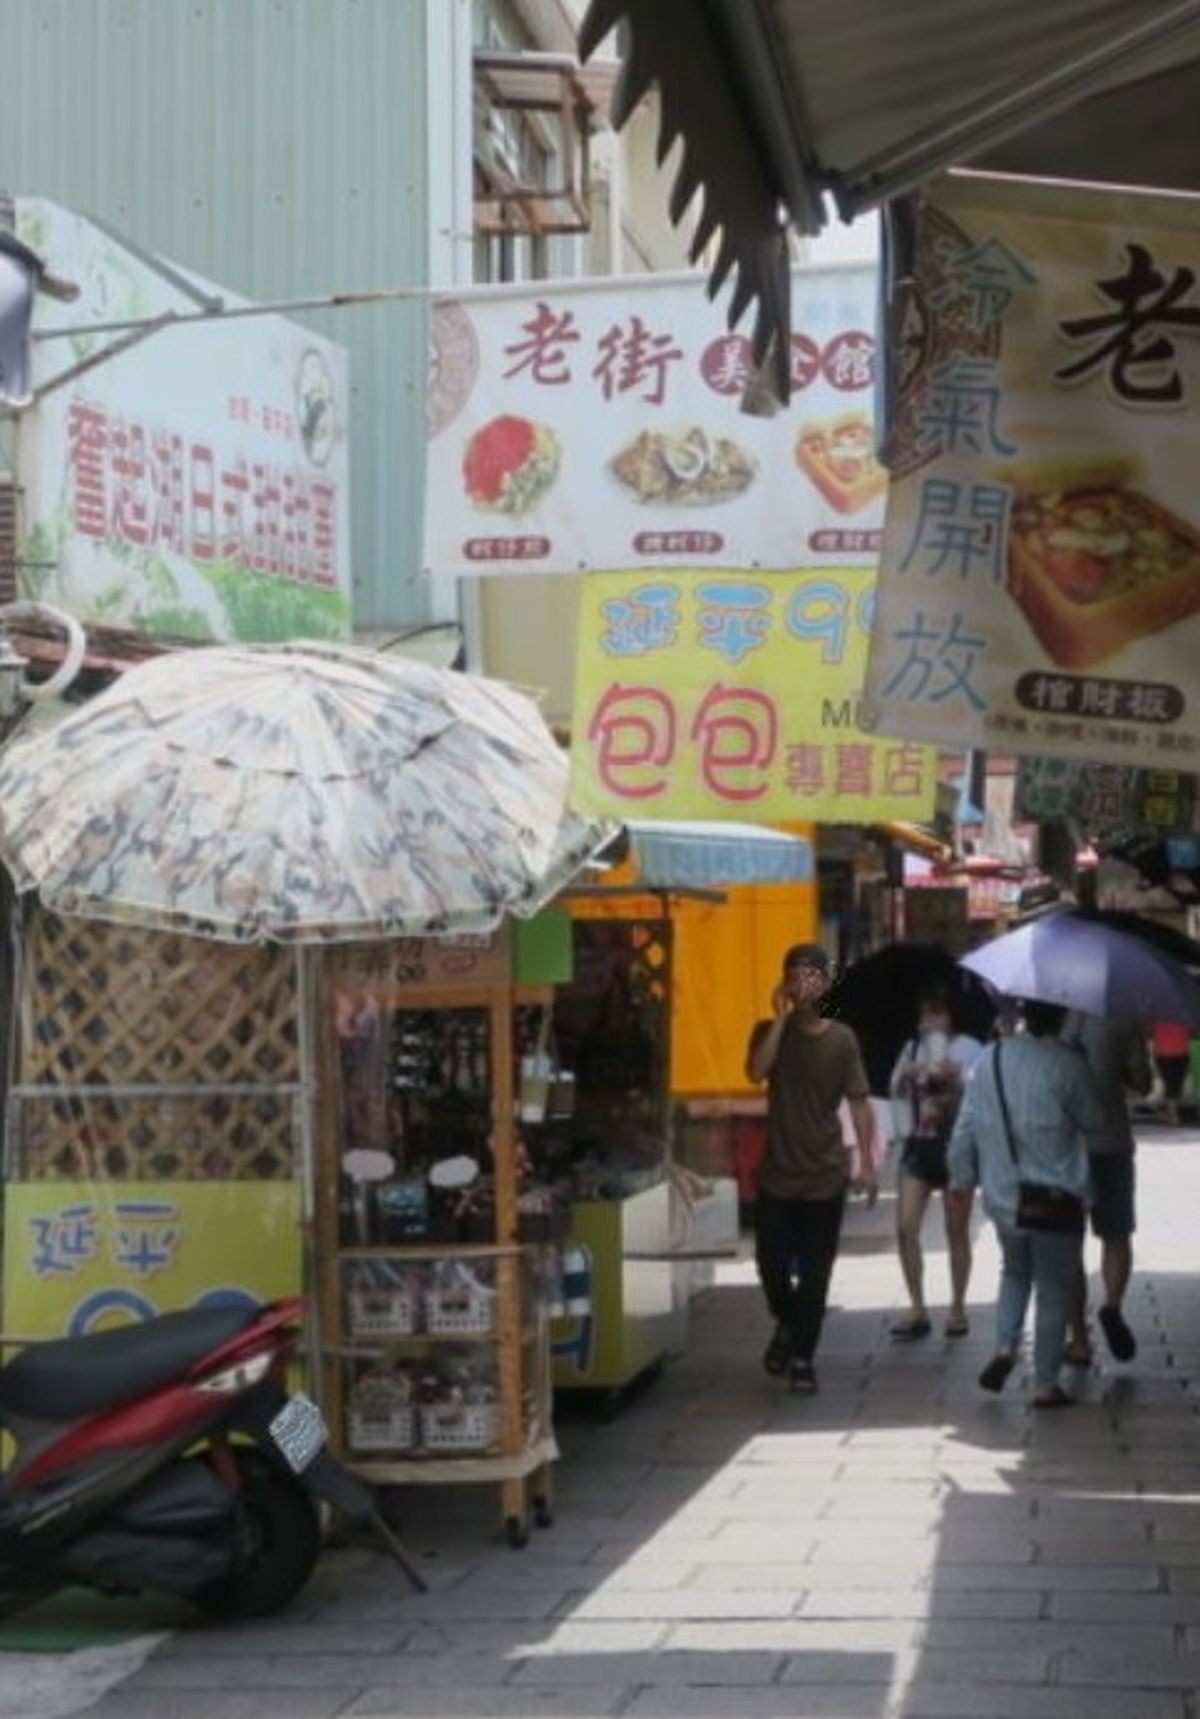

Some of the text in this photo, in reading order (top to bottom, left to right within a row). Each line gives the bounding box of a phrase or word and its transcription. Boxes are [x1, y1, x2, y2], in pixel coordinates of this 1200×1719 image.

[503, 303, 684, 406] 老街
[882, 237, 1038, 713] 冷氣開放
[602, 580, 880, 664] 延平9
[588, 682, 780, 801] 包包
[784, 741, 925, 798] 專賣店
[28, 1203, 179, 1276] 延平
